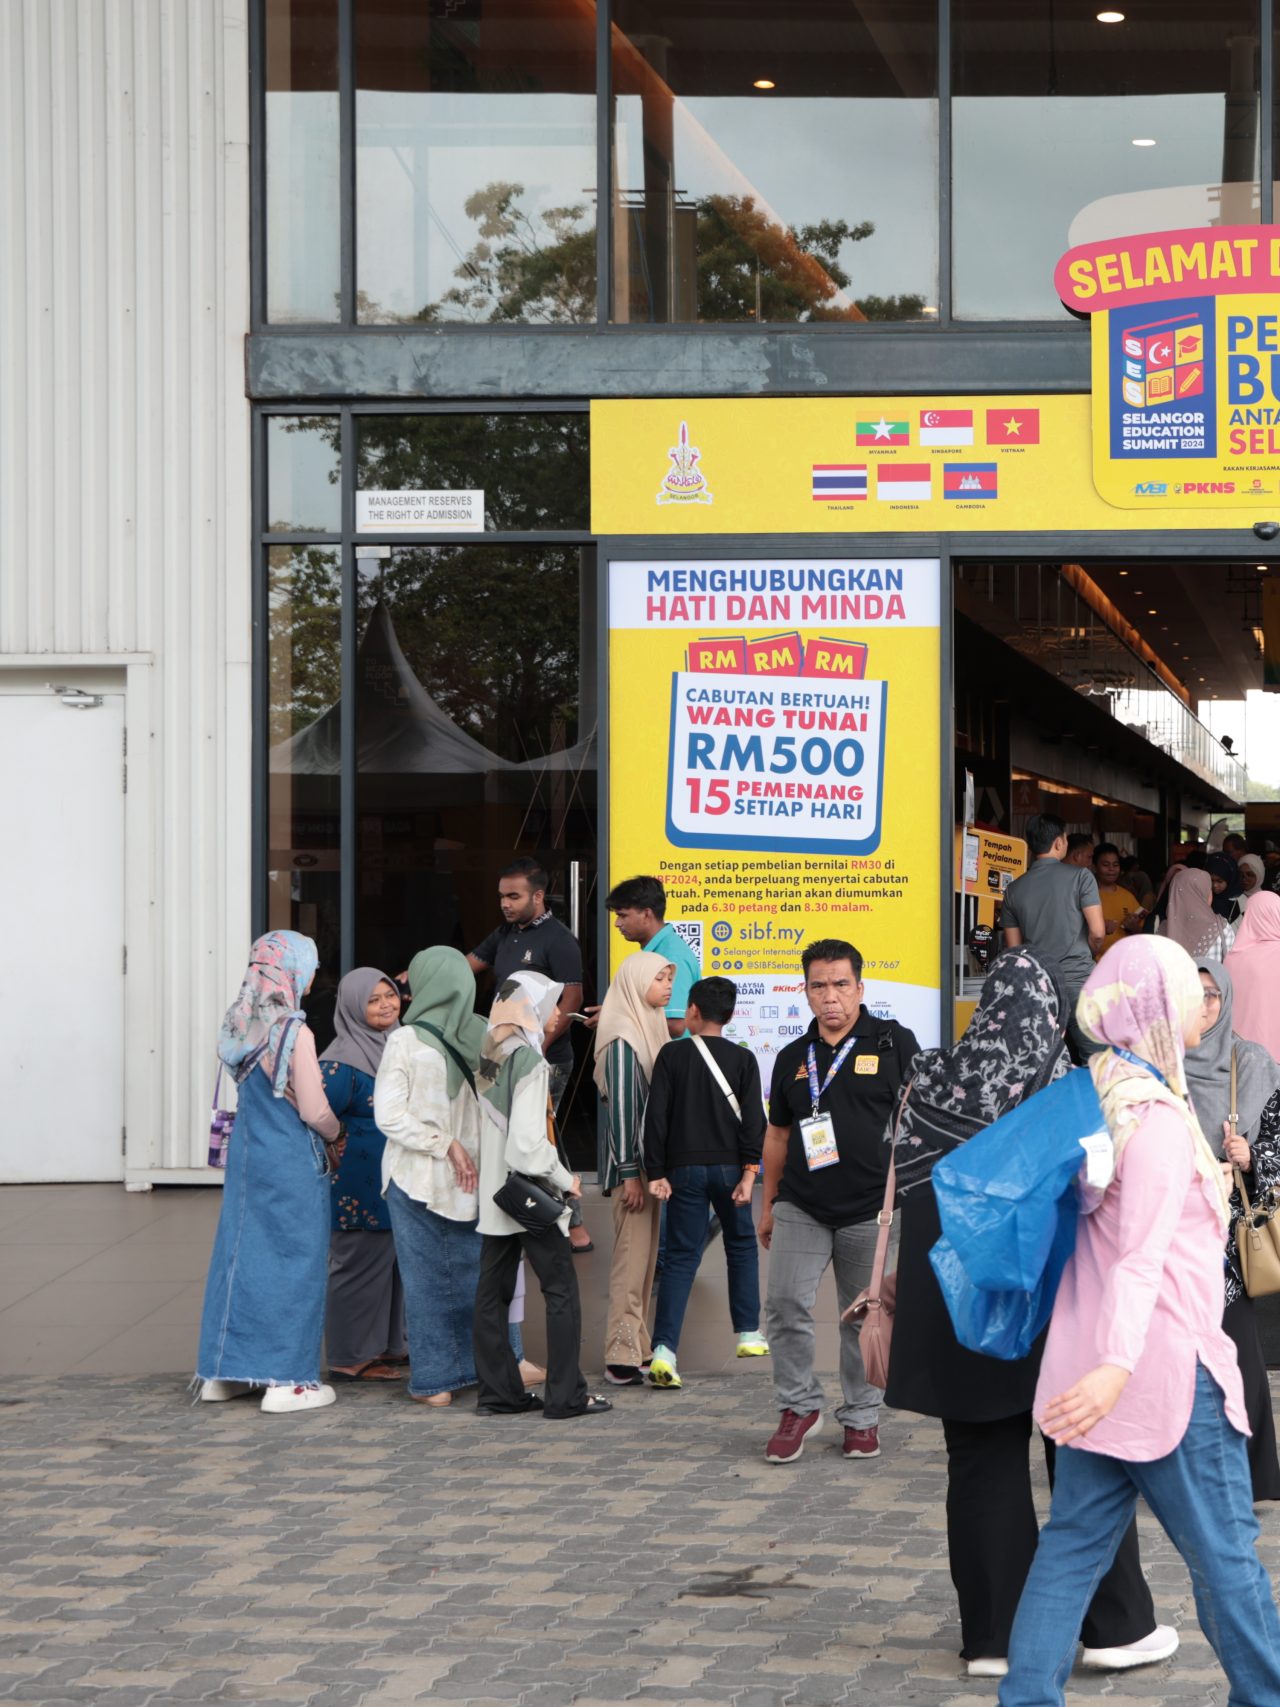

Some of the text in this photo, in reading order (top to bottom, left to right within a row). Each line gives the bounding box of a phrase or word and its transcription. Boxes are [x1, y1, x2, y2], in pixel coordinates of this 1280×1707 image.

[1069, 239, 1258, 299] SELAMAT
[1123, 413, 1204, 424] SELANGOR
[1123, 426, 1204, 436] EDUCATION
[1123, 439, 1178, 450] SUMMIT
[1184, 482, 1235, 494] PKNS
[368, 496, 472, 506] MANAGEMENT RESERVES
[369, 510, 472, 519] THE RIGHT OF ADMISSION
[648, 569, 903, 592] MENGHUBUNGKAN
[647, 594, 906, 621] HATI DAN MINDA
[700, 648, 854, 674] RM RM RM
[686, 689, 870, 709] CABUTAN BERTUAH!
[687, 706, 867, 731] WANG TUNAI
[687, 733, 864, 776] RM500
[686, 778, 731, 815] 15
[737, 781, 863, 800] PEMENANG
[735, 800, 862, 820] SETIAP HARI
[984, 839, 1012, 853] Tempah
[660, 860, 894, 872] Dengan setiap pembelian bernilai RM30 di
[983, 852, 1022, 866] Perjalanan
[652, 874, 908, 885] BF2024, anda berpeluang menyertai cabutan
[666, 888, 902, 900] rtuah. Pemenang harian akan diumumkan
[682, 902, 873, 914] pada 6.30 petang dan 8.30 malam.
[740, 921, 804, 944] sibf.my
[724, 947, 803, 958] Selangor Internatio
